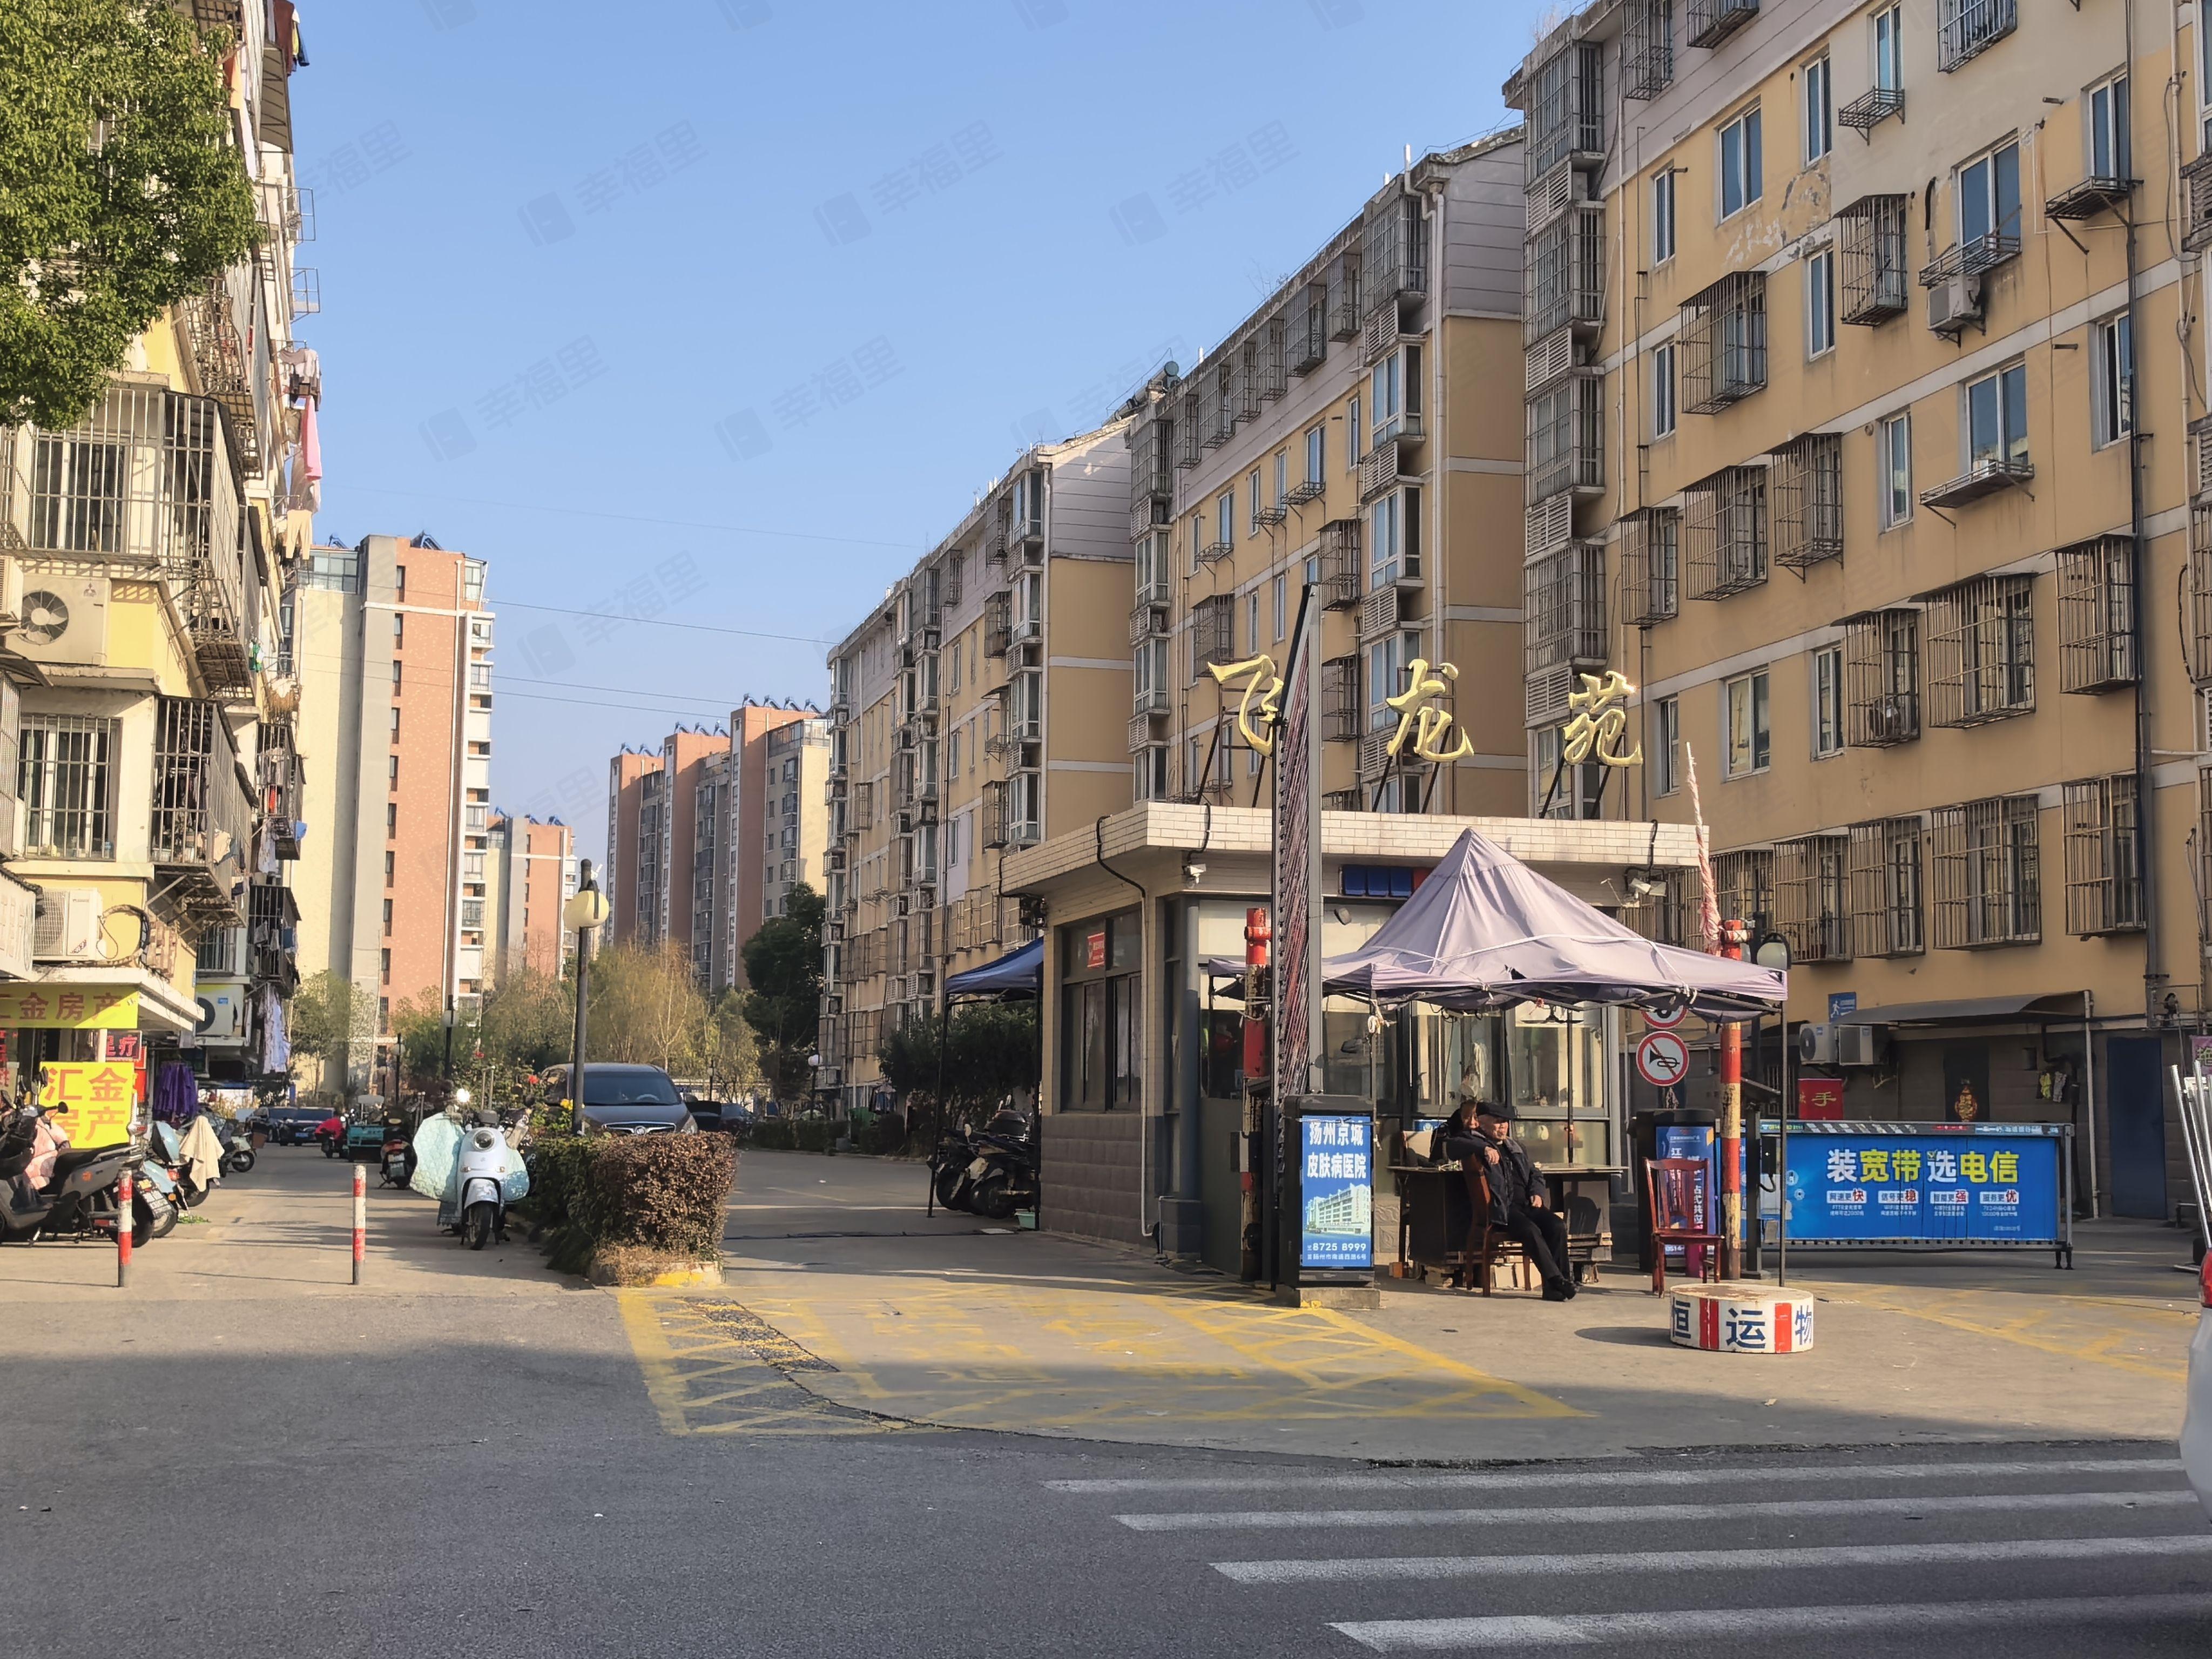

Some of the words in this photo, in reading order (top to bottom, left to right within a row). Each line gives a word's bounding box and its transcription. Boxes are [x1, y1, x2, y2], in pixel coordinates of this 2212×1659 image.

[1208, 653, 1644, 767] 飞龙苑
[0, 992, 121, 1021] 金房产
[45, 1067, 128, 1101] 汇金
[1307, 1152, 1366, 1178] 皮肤病医院
[1313, 1243, 1338, 1251] 8725
[1341, 1243, 1366, 1251] 8999
